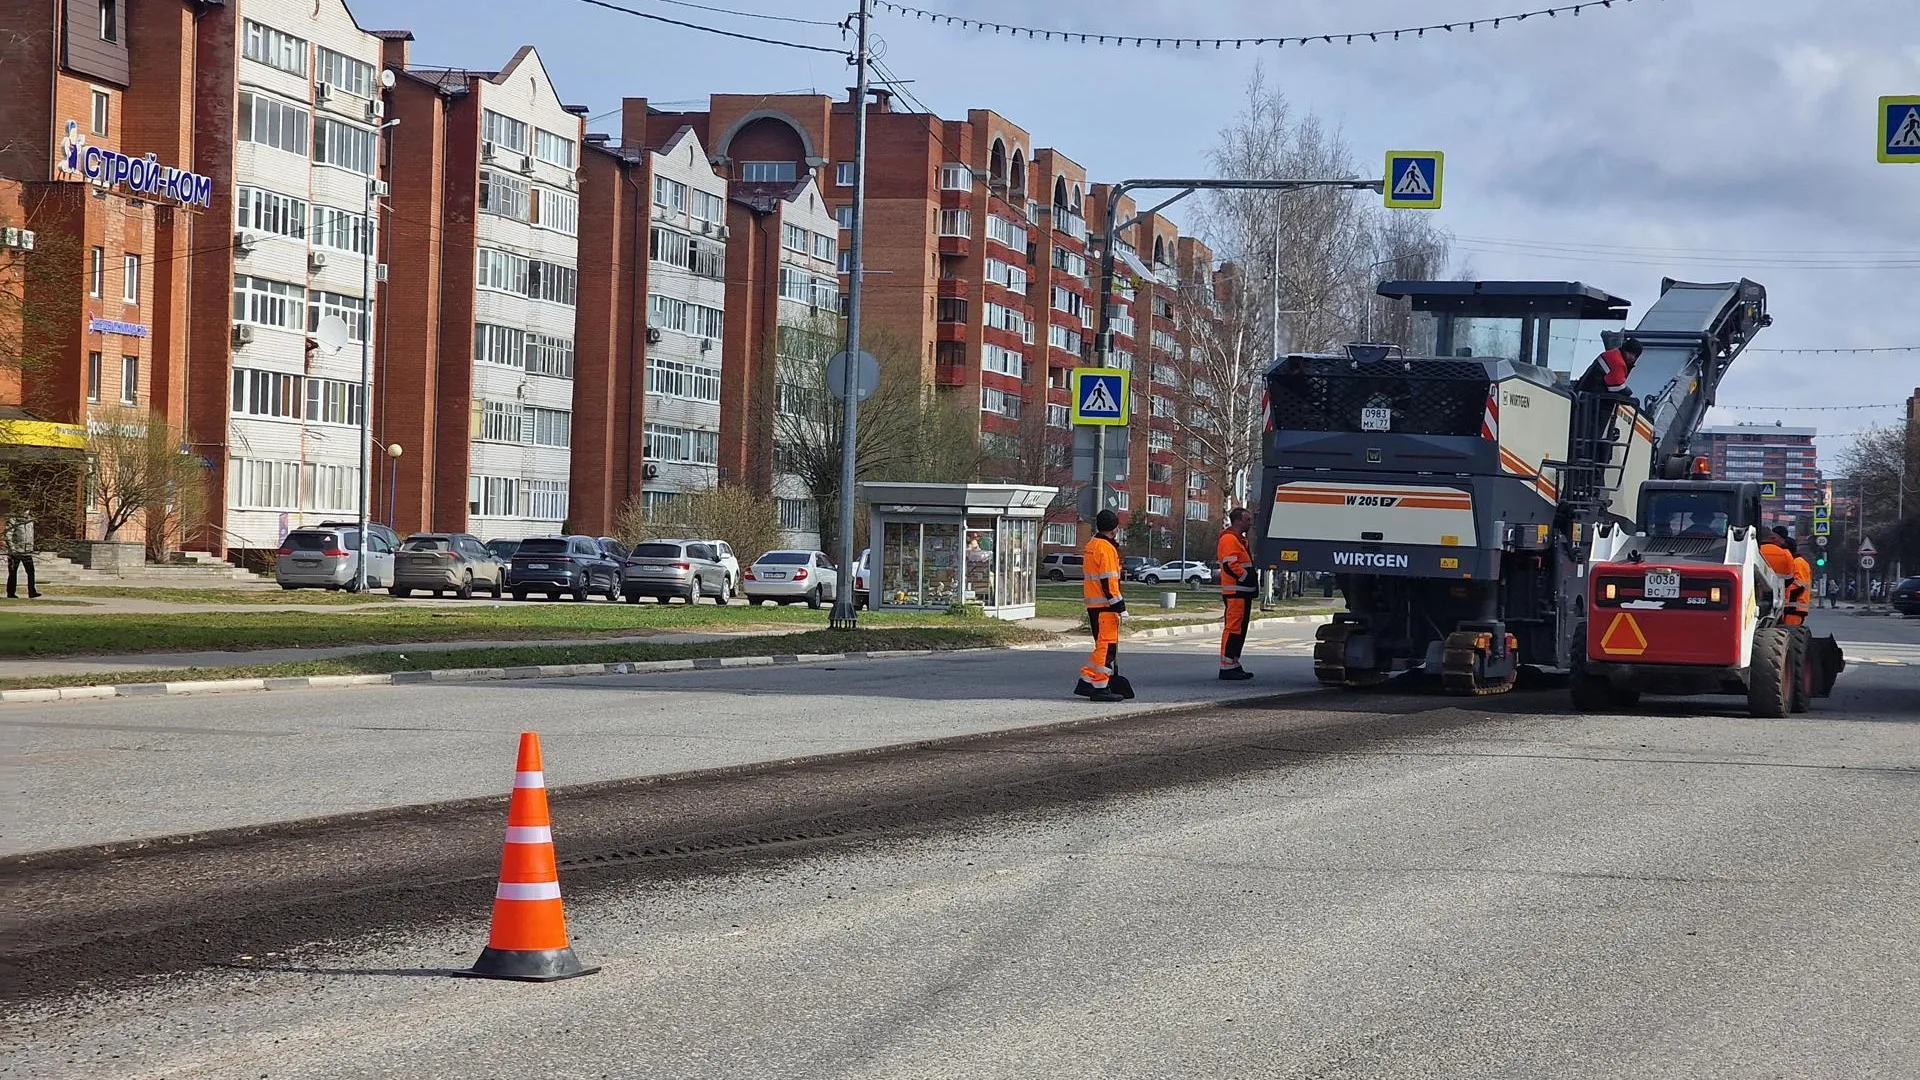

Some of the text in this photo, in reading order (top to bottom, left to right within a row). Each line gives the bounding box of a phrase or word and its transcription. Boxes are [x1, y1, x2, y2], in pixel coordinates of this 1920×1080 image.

[84, 145, 211, 207] СТРОЙ-КОМ
[1509, 394, 1531, 409] WIRTGEN
[1365, 410, 1387, 419] 0983
[1346, 495, 1357, 506] W
[1359, 496, 1378, 507] 205
[1333, 552, 1409, 568] WIRTGEN
[1649, 575, 1676, 585] 0038
[1686, 597, 1707, 605] S630
